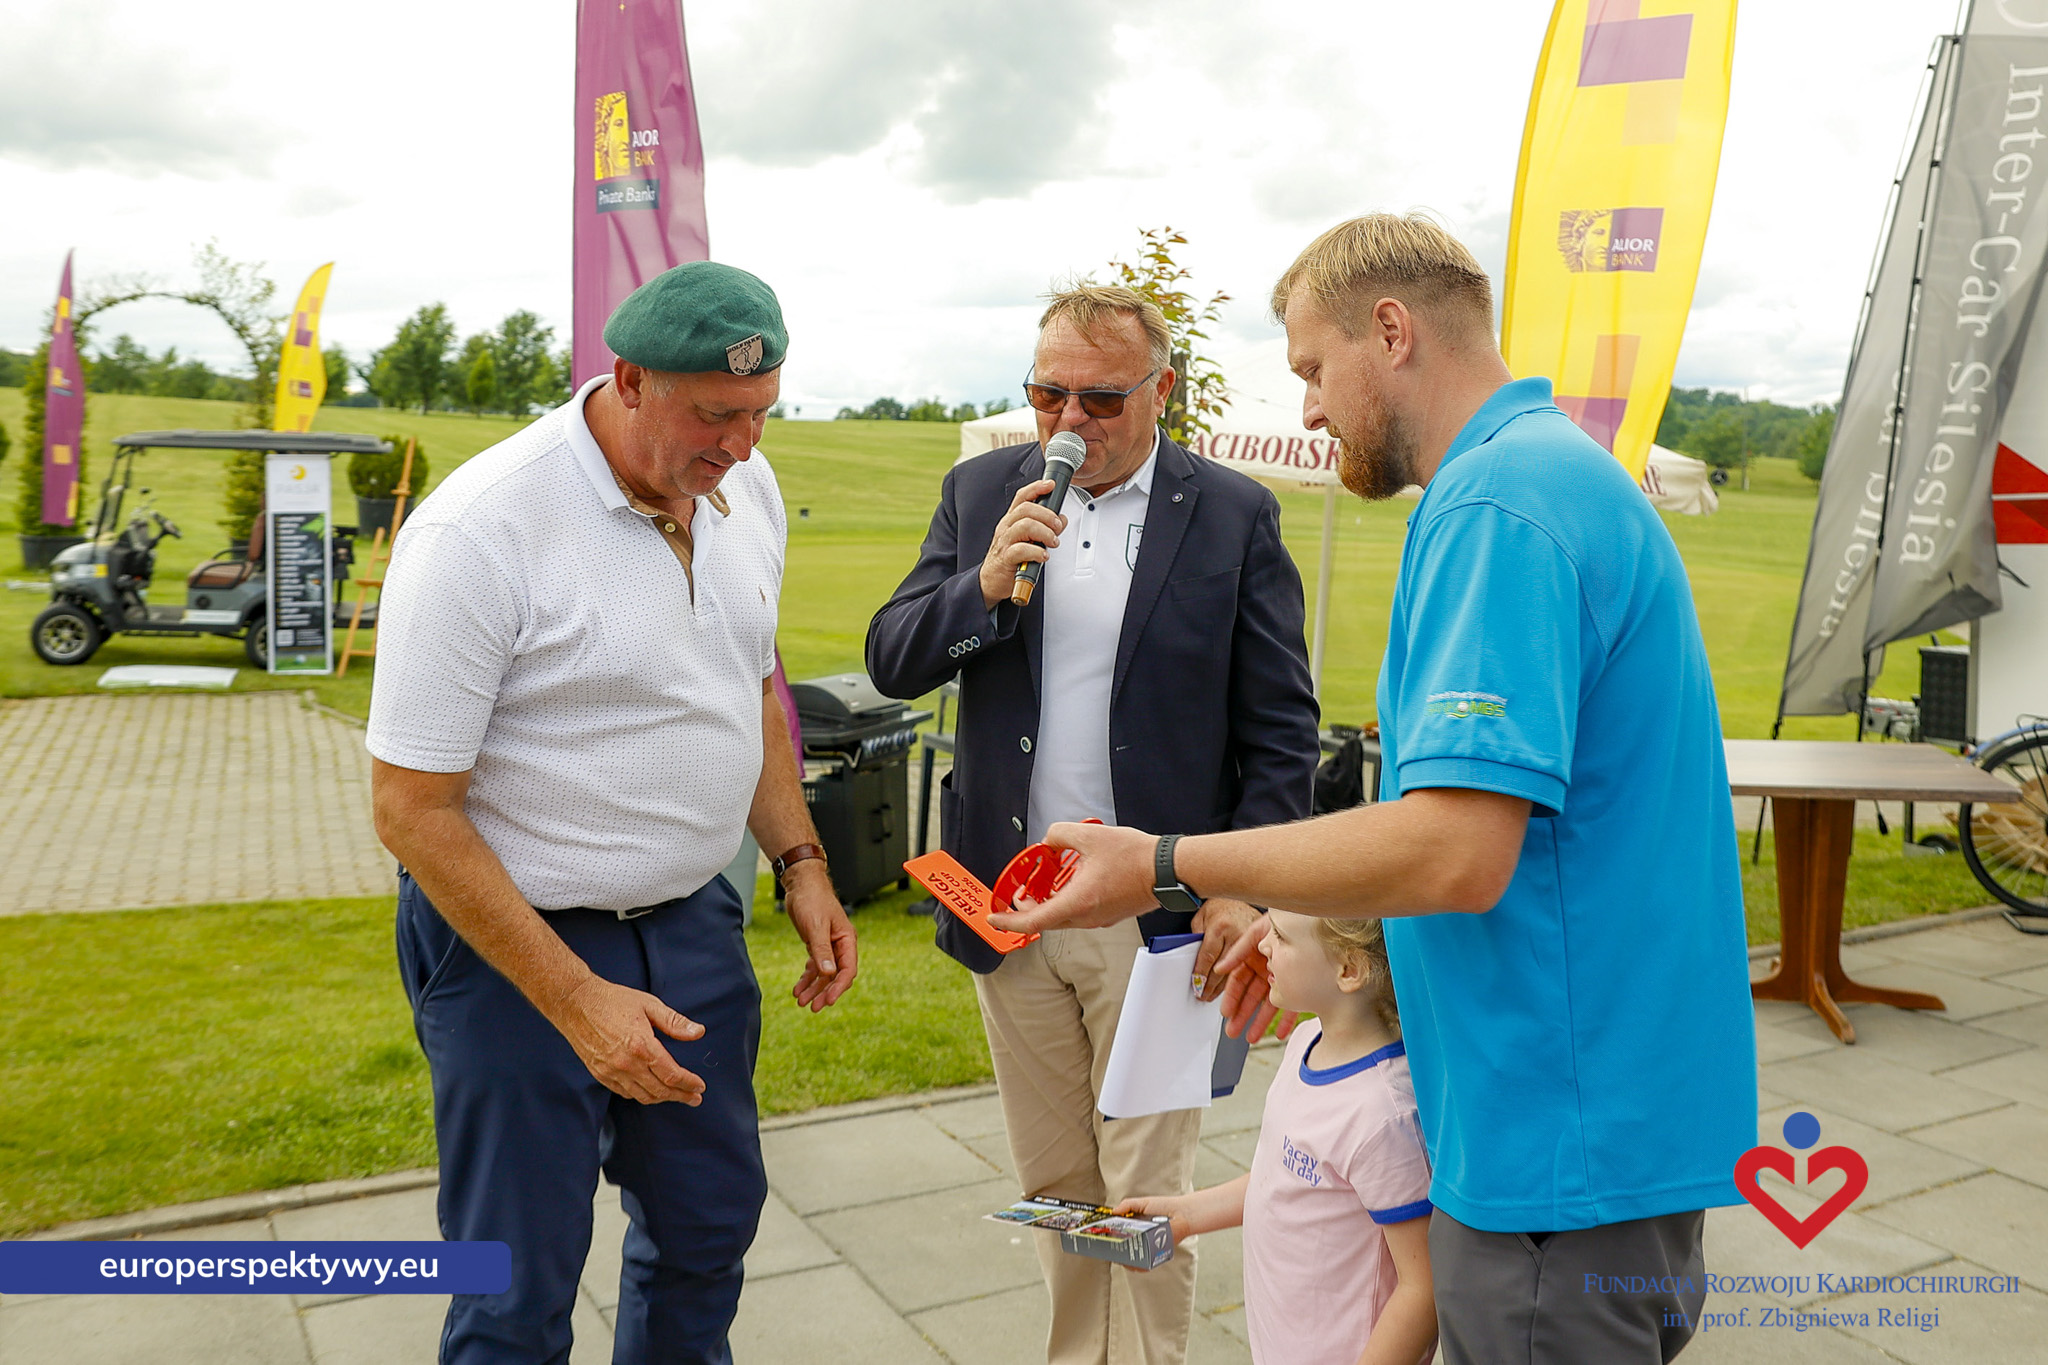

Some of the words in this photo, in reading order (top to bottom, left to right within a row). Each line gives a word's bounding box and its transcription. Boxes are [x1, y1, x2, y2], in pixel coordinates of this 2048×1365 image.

[1899, 361, 1993, 566] Silesia
[927, 872, 979, 917] RELIGA
[940, 871, 961, 888] CUP
[958, 887, 984, 908] GOLF
[1282, 1134, 1318, 1171] Vacay
[1282, 1155, 1296, 1172] all
[1297, 1164, 1322, 1188] day
